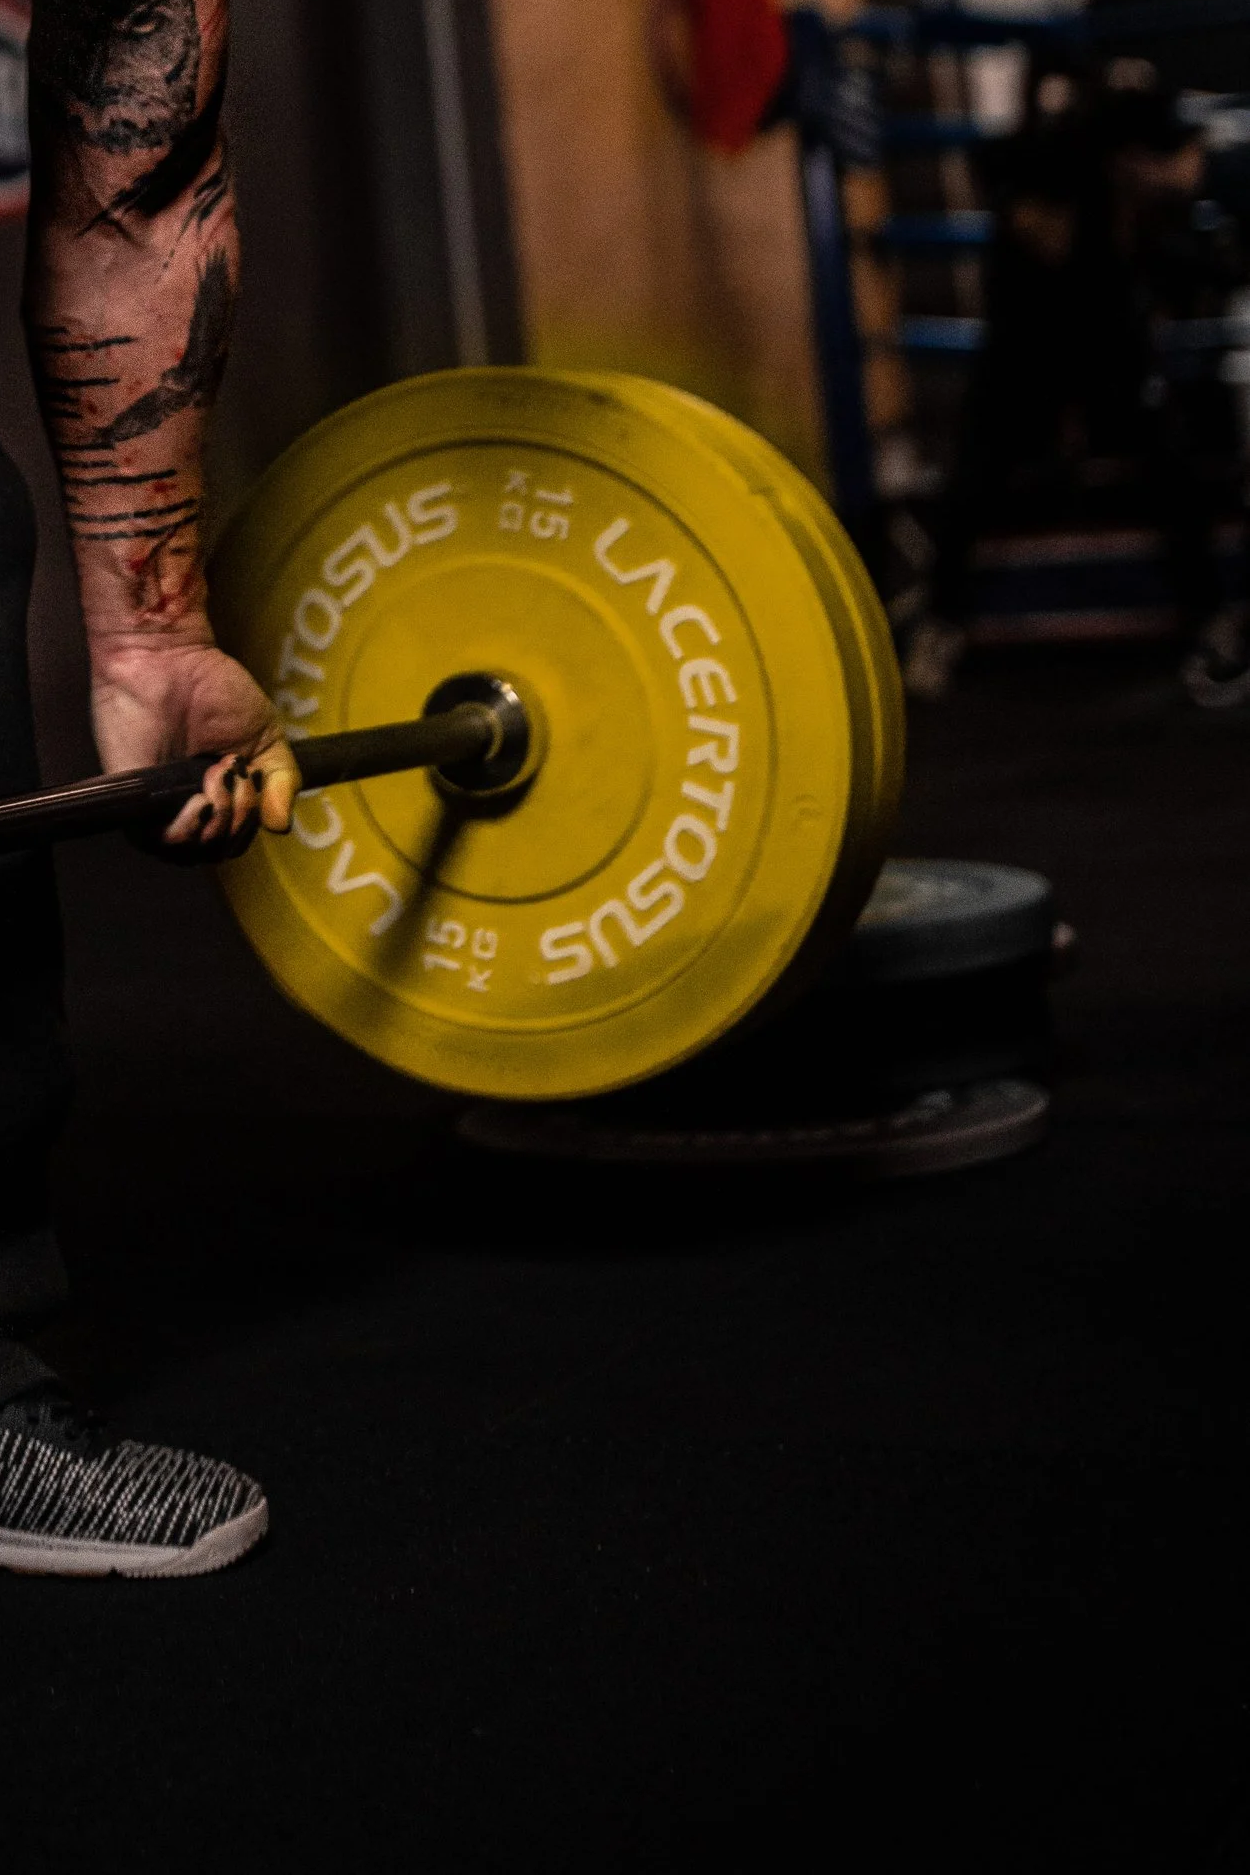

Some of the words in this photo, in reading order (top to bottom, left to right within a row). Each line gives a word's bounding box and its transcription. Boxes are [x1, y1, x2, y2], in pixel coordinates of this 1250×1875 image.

[531, 488, 573, 540] 15
[541, 516, 741, 986] LACERTOSUS
[422, 919, 467, 971] 15
